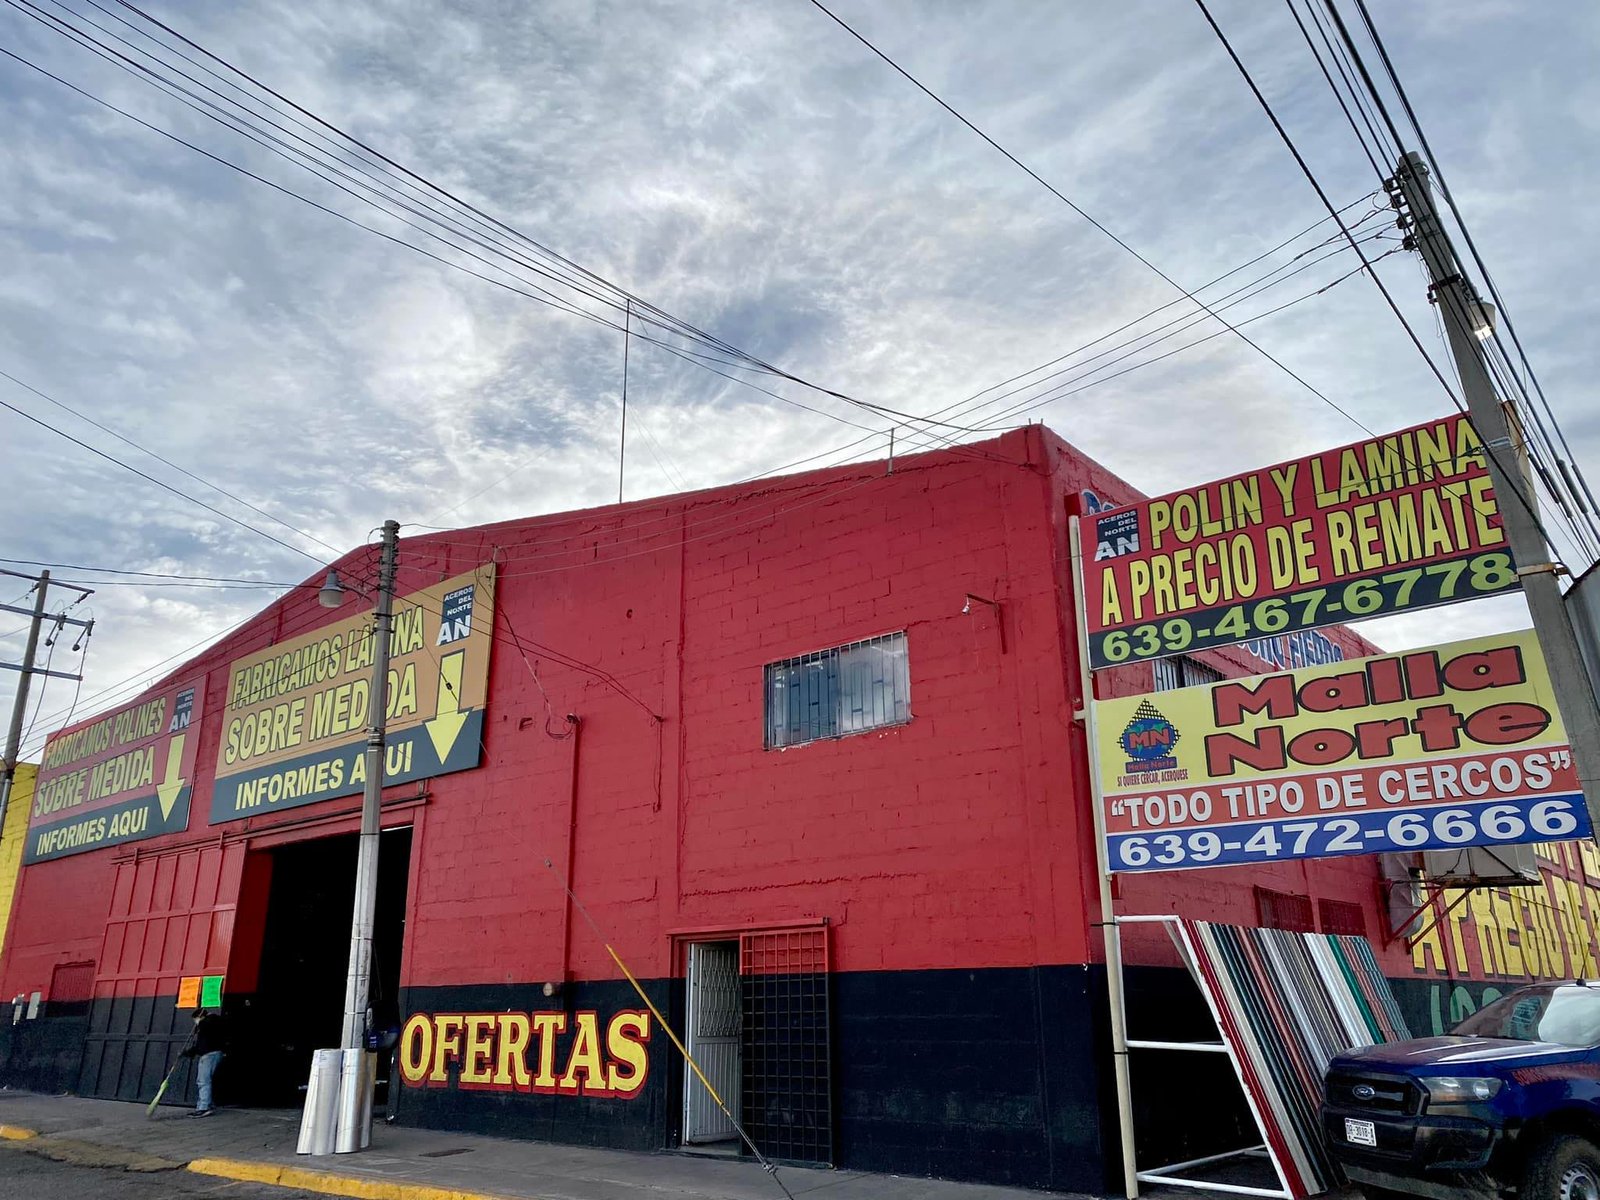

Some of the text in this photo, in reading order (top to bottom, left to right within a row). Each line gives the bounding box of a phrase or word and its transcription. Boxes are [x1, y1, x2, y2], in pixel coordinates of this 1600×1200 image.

[1148, 417, 1488, 550] POLIN Y LAMINA
[1098, 510, 1137, 525] ACEROS
[1104, 523, 1138, 537] NORTE
[1118, 517, 1137, 527] DEL
[1094, 533, 1140, 562] AN
[1101, 474, 1505, 628] A PRECIO DE REMATE
[445, 586, 473, 602] ACEROS
[447, 602, 472, 616] NORTE
[458, 595, 472, 605] DEL
[1102, 552, 1513, 663] 639-467-6778
[231, 604, 424, 710] FABRICAMOS LAINA
[435, 614, 471, 646] AN
[225, 662, 417, 765] SOBRE MEDDA
[1211, 645, 1527, 728] Malla
[42, 697, 166, 773] FABRICAMOS POLINES
[168, 711, 191, 733] AN
[1129, 728, 1170, 749] MN
[1204, 702, 1552, 778] Norte
[34, 745, 155, 818] SOBRE MEDIDA
[234, 740, 413, 811] INFORMES AUI
[1221, 780, 1305, 818] TIPO
[1316, 773, 1367, 810] DE
[36, 806, 149, 856] INFORMES AQUI
[1119, 800, 1577, 866] 639-472-6666
[399, 1010, 651, 1098] OFERTAS
